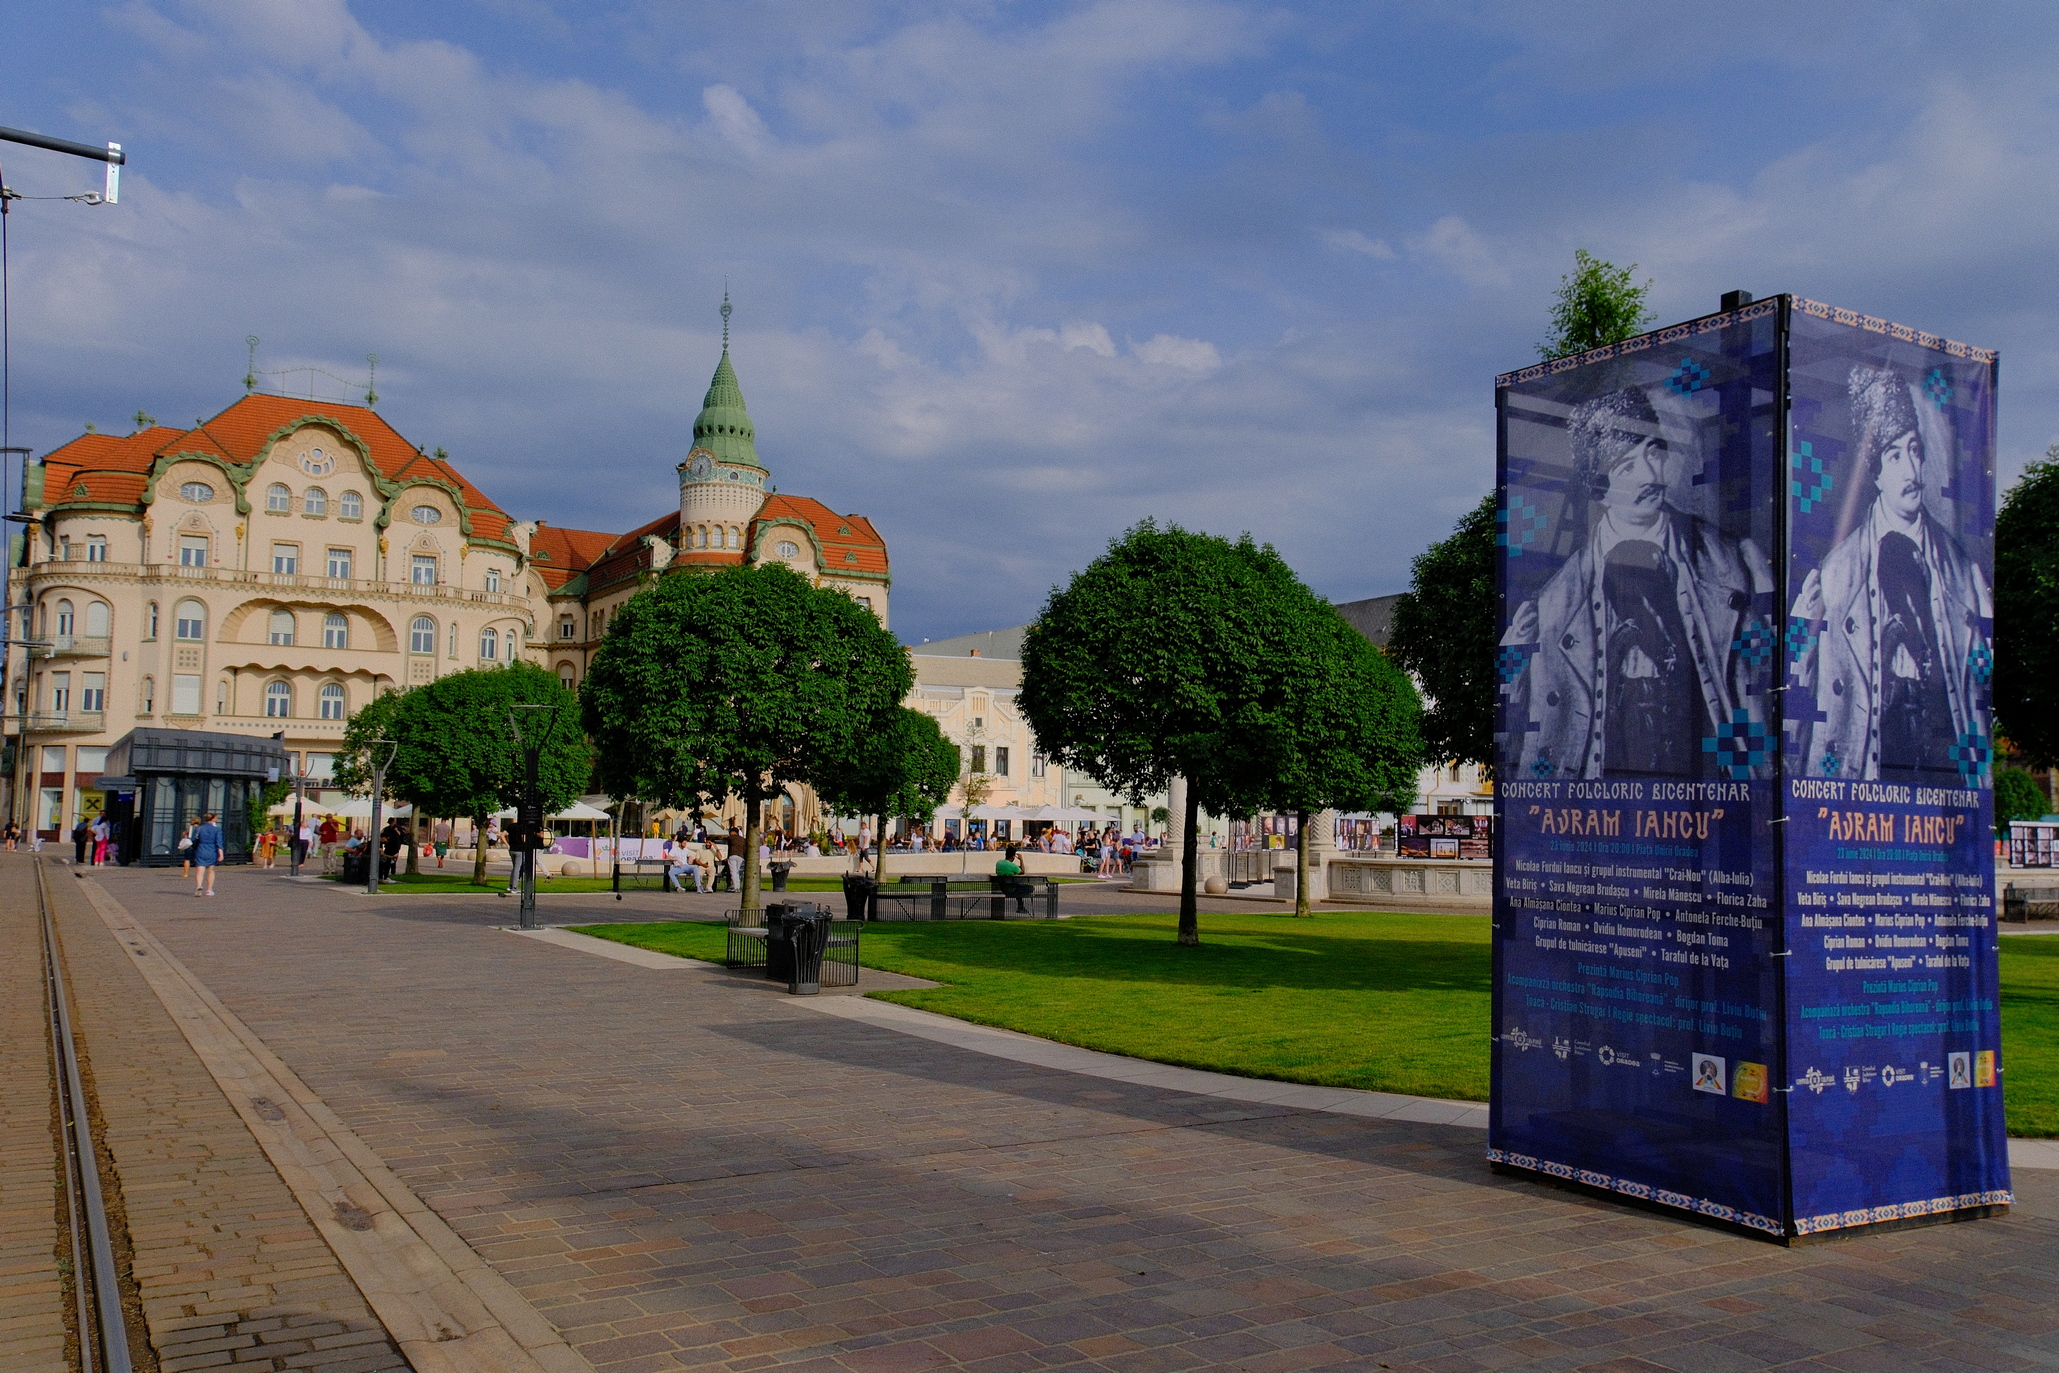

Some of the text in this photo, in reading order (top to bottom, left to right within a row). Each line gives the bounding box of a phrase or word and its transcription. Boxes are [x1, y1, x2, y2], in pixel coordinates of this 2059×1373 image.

[1502, 782, 1750, 800] CONCERT FOLCLORIC BICENTENAR
[1792, 780, 1979, 808] CONCERT FOLCLORIC BICENTENAR
[1576, 841, 1592, 852] 2024
[1516, 860, 1540, 872] Nicolae
[1542, 861, 1562, 873] Furdui
[1564, 862, 1581, 875] Iancu
[1592, 864, 1614, 878] grupul
[1616, 864, 1661, 880] instrumental
[1664, 868, 1706, 882] "Crai-Nou"
[1709, 870, 1754, 887] (Alba-Iulia)
[1506, 877, 1520, 889] Veta
[1549, 880, 1565, 892] Sava
[1566, 881, 1594, 896] Negrean
[1643, 886, 1666, 900] Mirela
[1717, 892, 1744, 906] Florica
[1747, 894, 1767, 908] Zaha
[1510, 896, 1521, 908] Ana
[1556, 899, 1580, 912] Ciontea
[1594, 902, 1617, 915] Marius
[1620, 904, 1645, 919] Ciprian
[1647, 907, 1661, 922] Pop
[1675, 909, 1709, 924] Antonela
[1534, 916, 1728, 947] Ciprian Roman Ovidiu Homorodean Bogdan Toma
[1536, 935, 1556, 950] Grupul
[1559, 938, 1566, 950] de
[1609, 943, 1647, 958] "Apuseni"
[1661, 948, 1687, 962] Taraful
[1690, 951, 1699, 965] de
[1702, 953, 1709, 966] la
